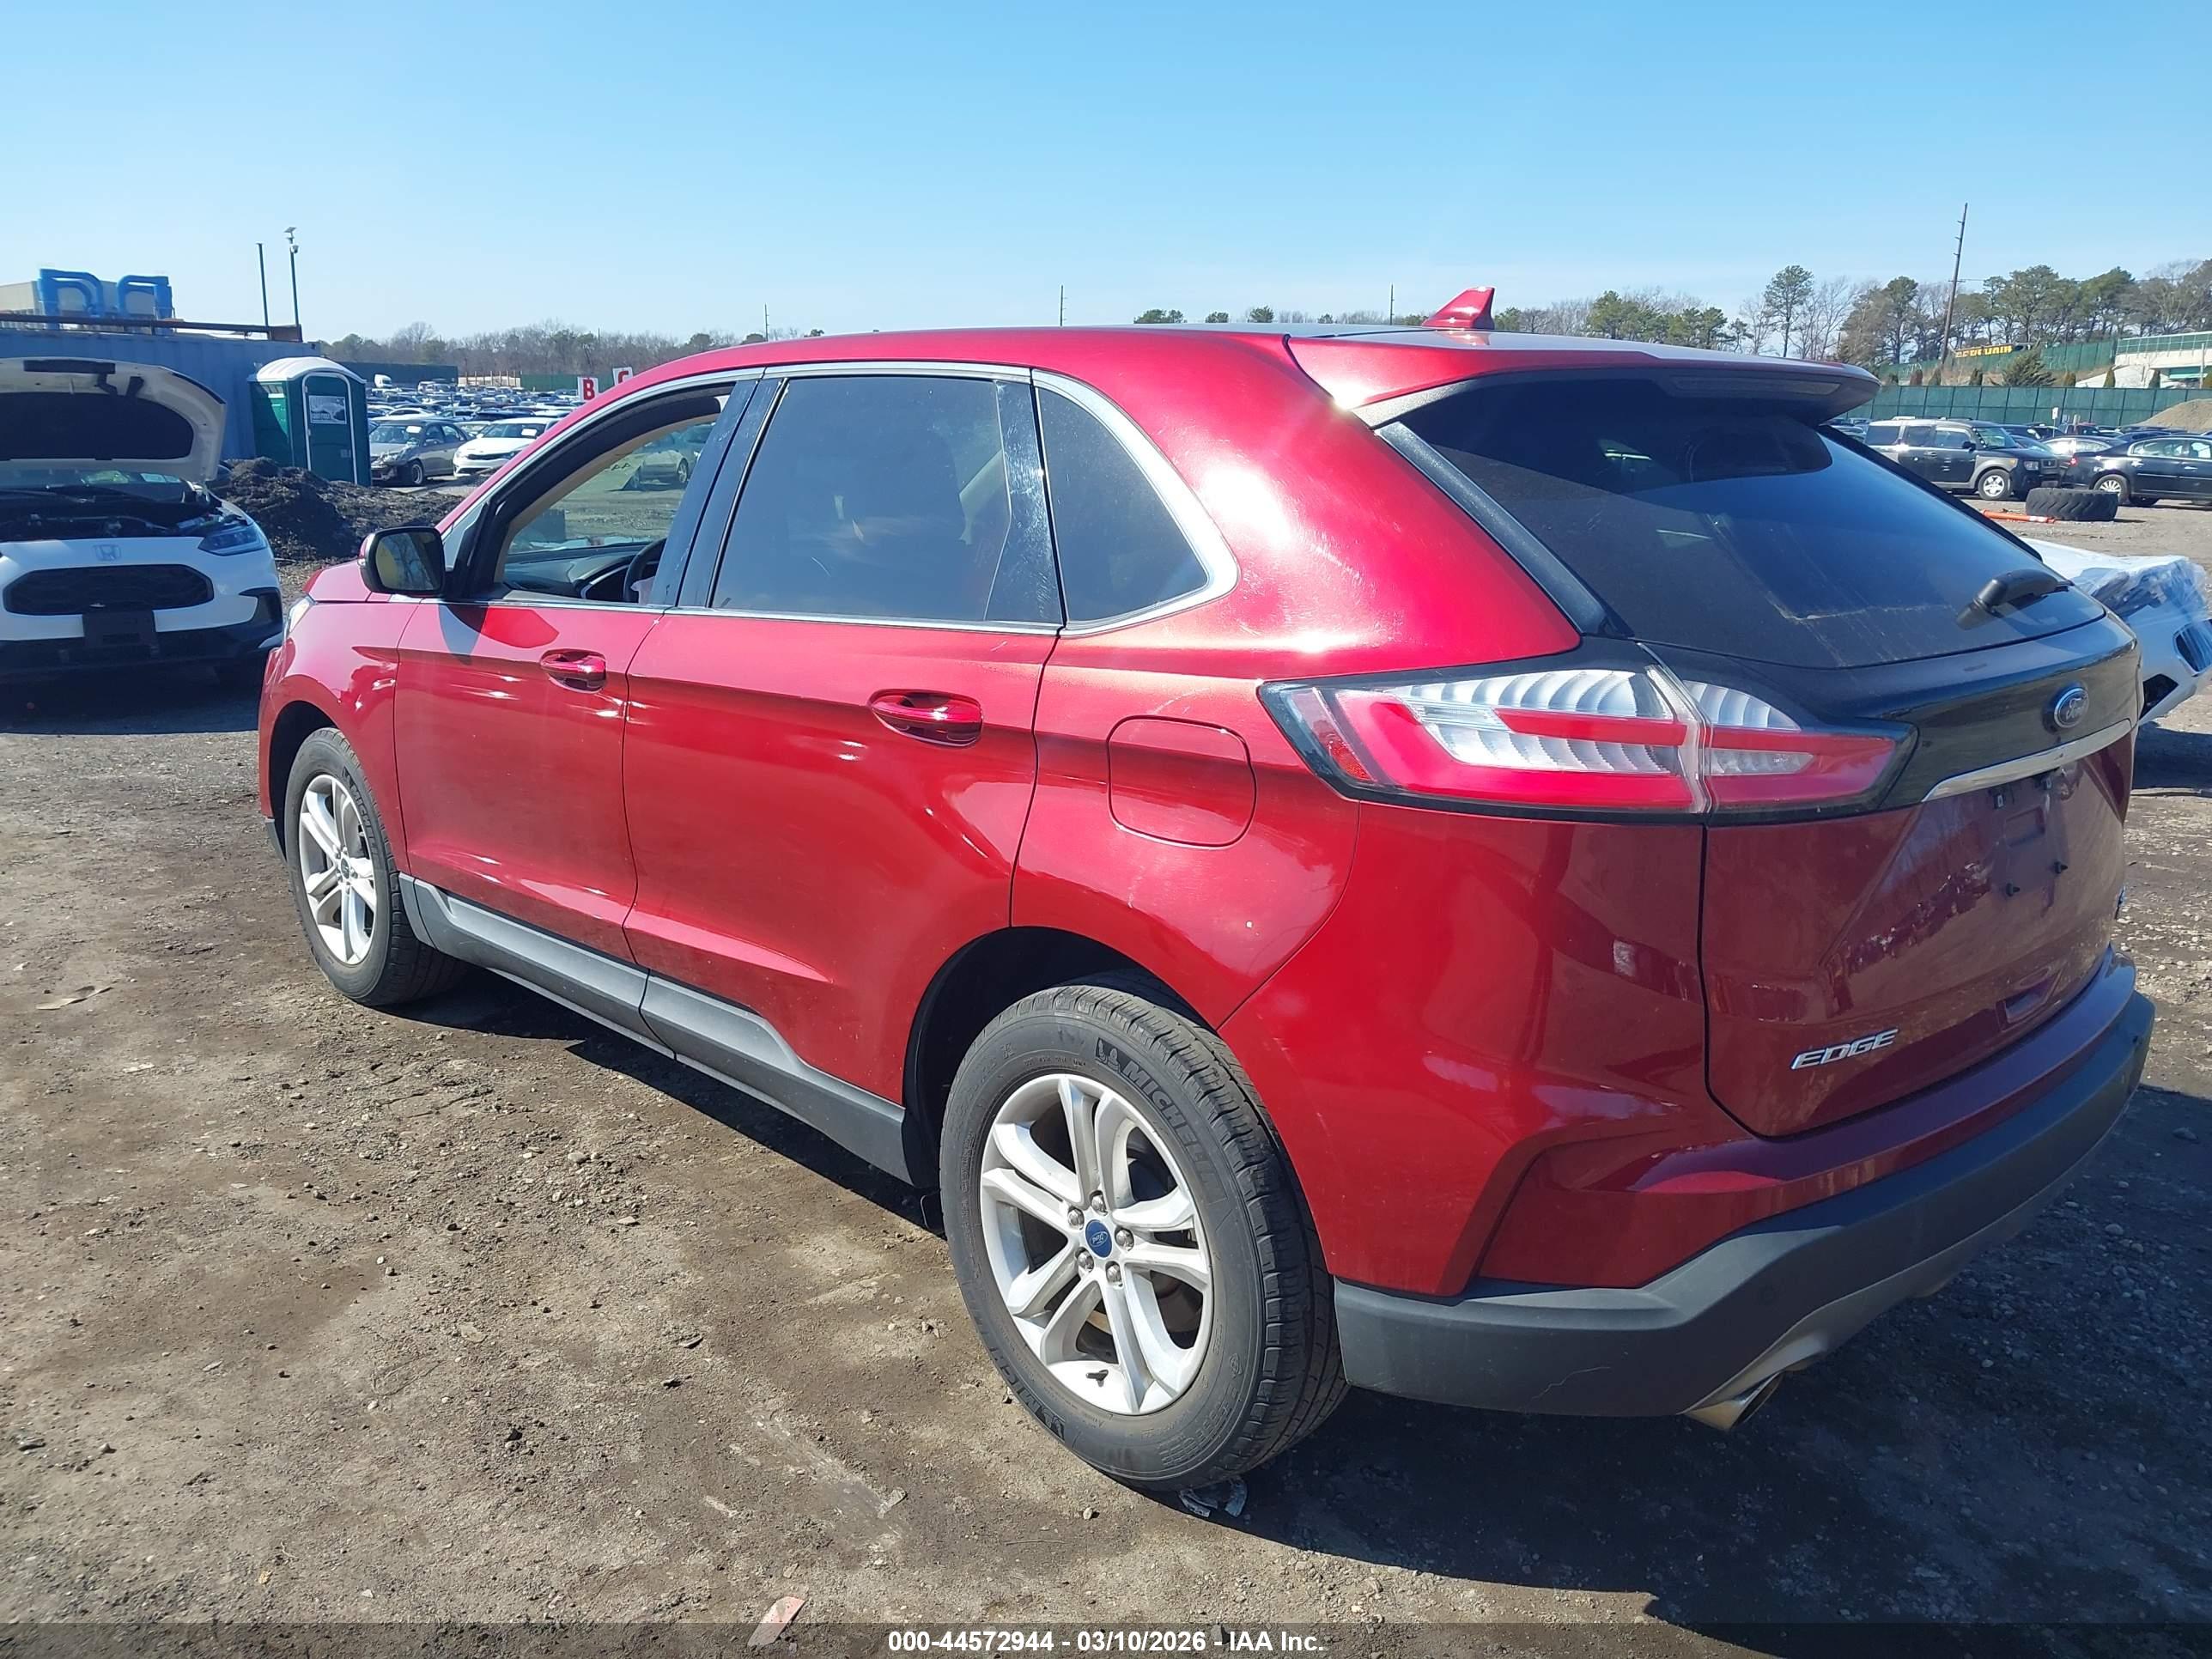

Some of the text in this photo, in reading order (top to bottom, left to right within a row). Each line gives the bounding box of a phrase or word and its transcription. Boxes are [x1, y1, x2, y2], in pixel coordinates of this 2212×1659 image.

[582, 379, 595, 400] B
[1791, 1029, 1899, 1070] EDGE
[1122, 1058, 1228, 1202] MICHELIN
